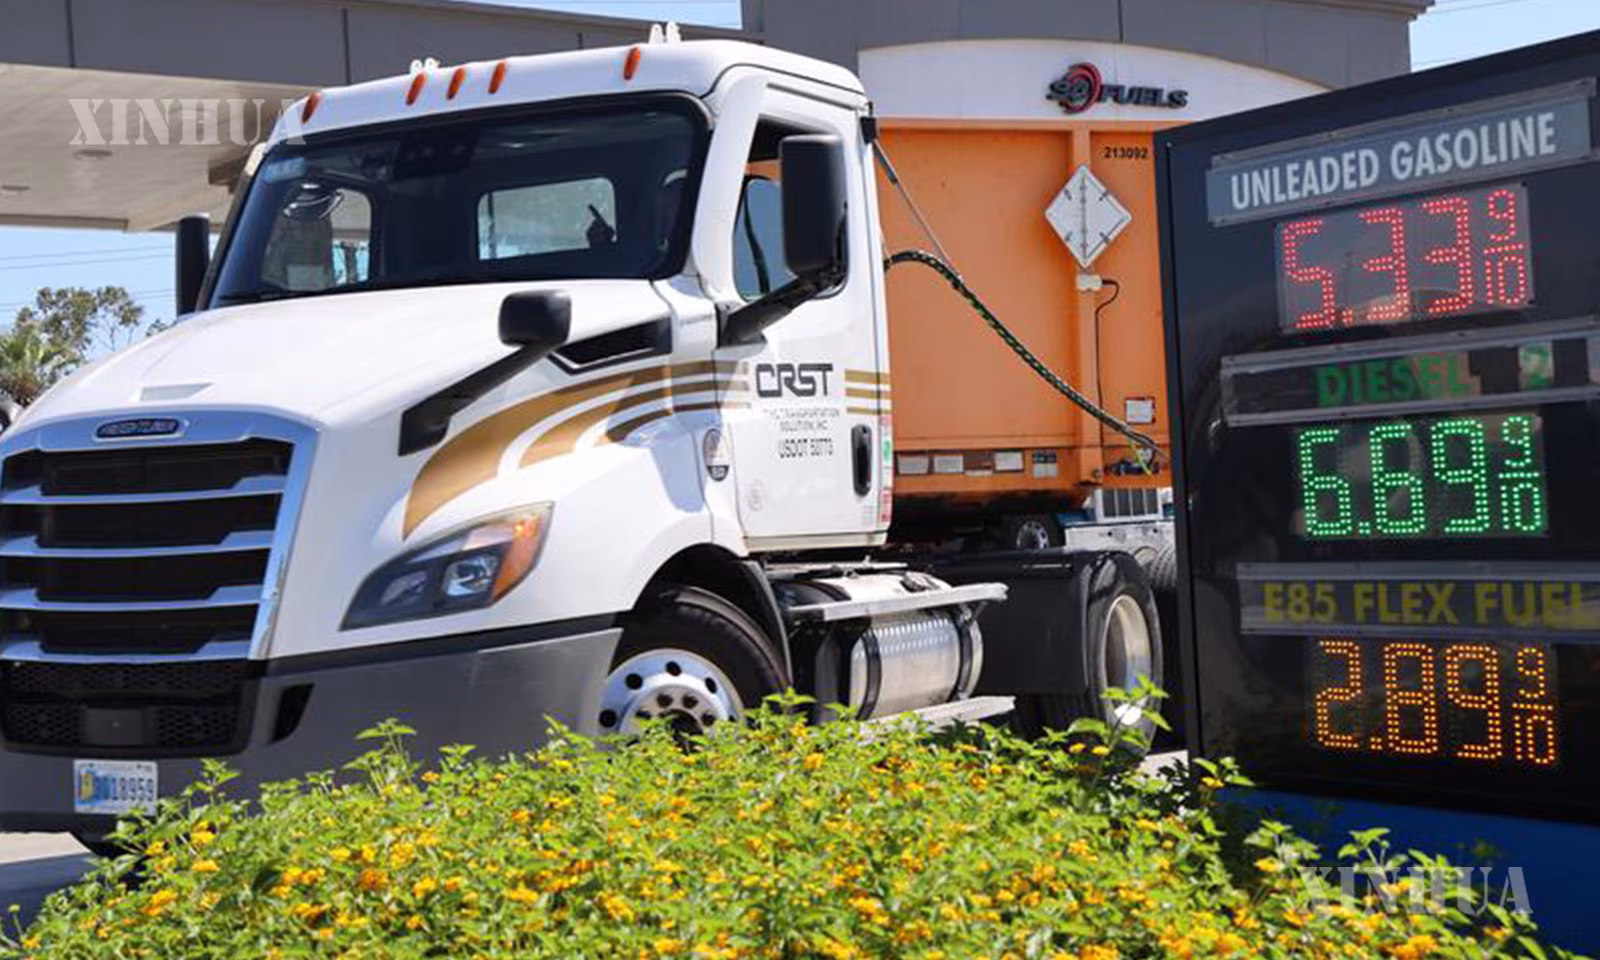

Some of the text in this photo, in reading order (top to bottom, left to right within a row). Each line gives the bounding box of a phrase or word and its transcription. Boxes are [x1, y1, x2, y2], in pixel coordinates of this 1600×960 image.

[1099, 84, 1189, 109] FUELS
[1104, 146, 1148, 159] 213092
[1231, 112, 1557, 211] UNLEADED GASOLINE
[756, 363, 834, 398] CRST
[1316, 352, 1475, 407] DIESEL
[1262, 582, 1338, 624] E85
[1353, 583, 1459, 626] FLEX
[1314, 638, 1504, 760] 2.89
